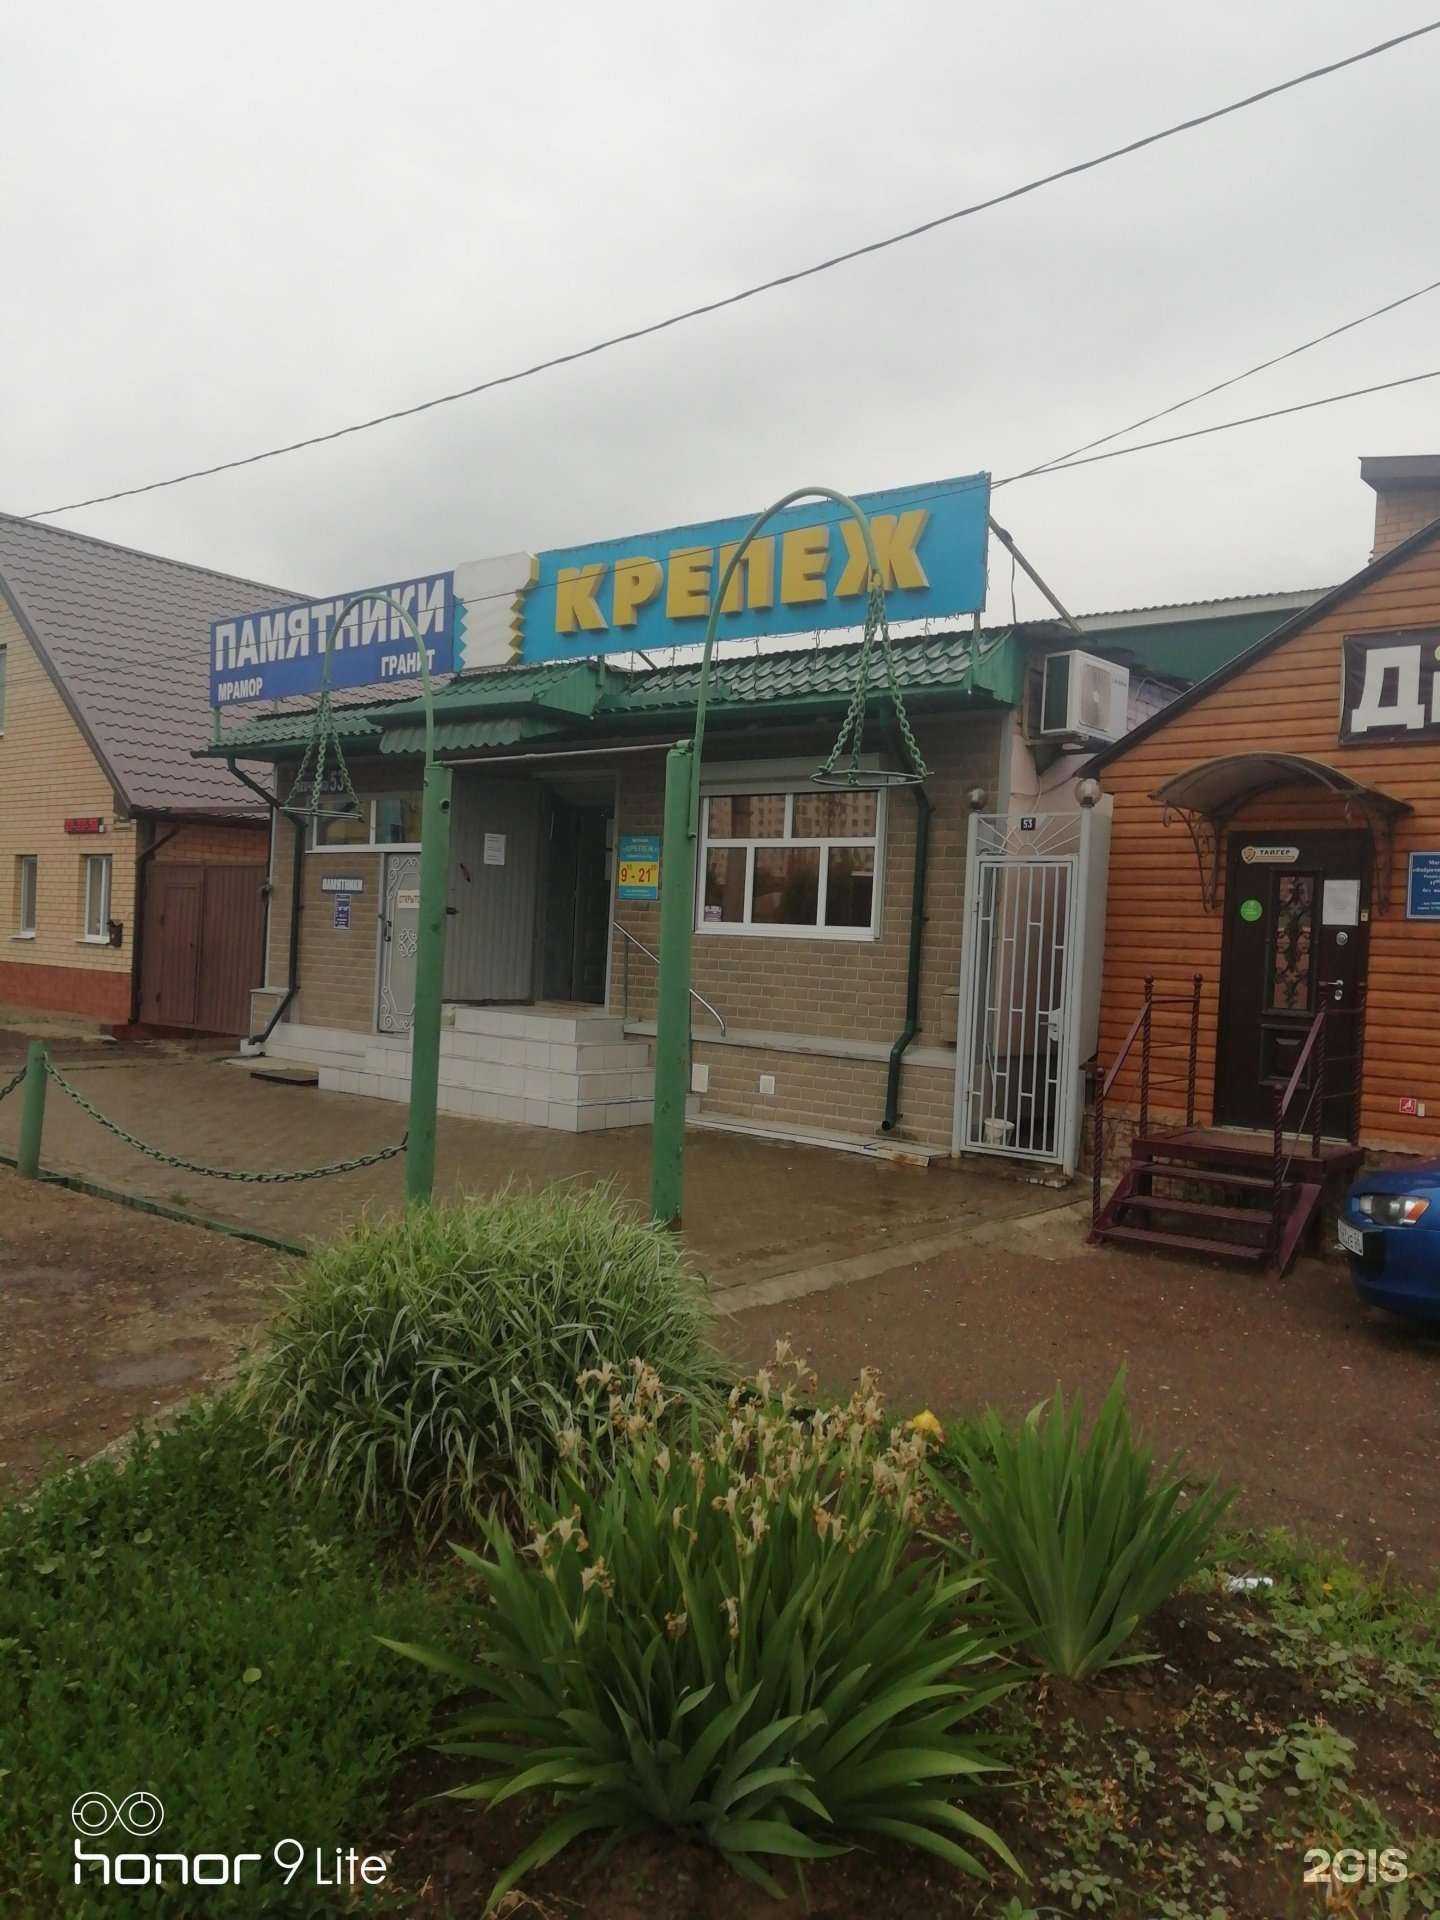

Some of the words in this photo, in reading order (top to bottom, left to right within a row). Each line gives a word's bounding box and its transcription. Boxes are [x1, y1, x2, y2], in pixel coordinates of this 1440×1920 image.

[555, 508, 931, 634] КРЕПЕЖ
[215, 579, 445, 671] ПАМЯТНИКИ
[218, 677, 264, 702] МРАМОР
